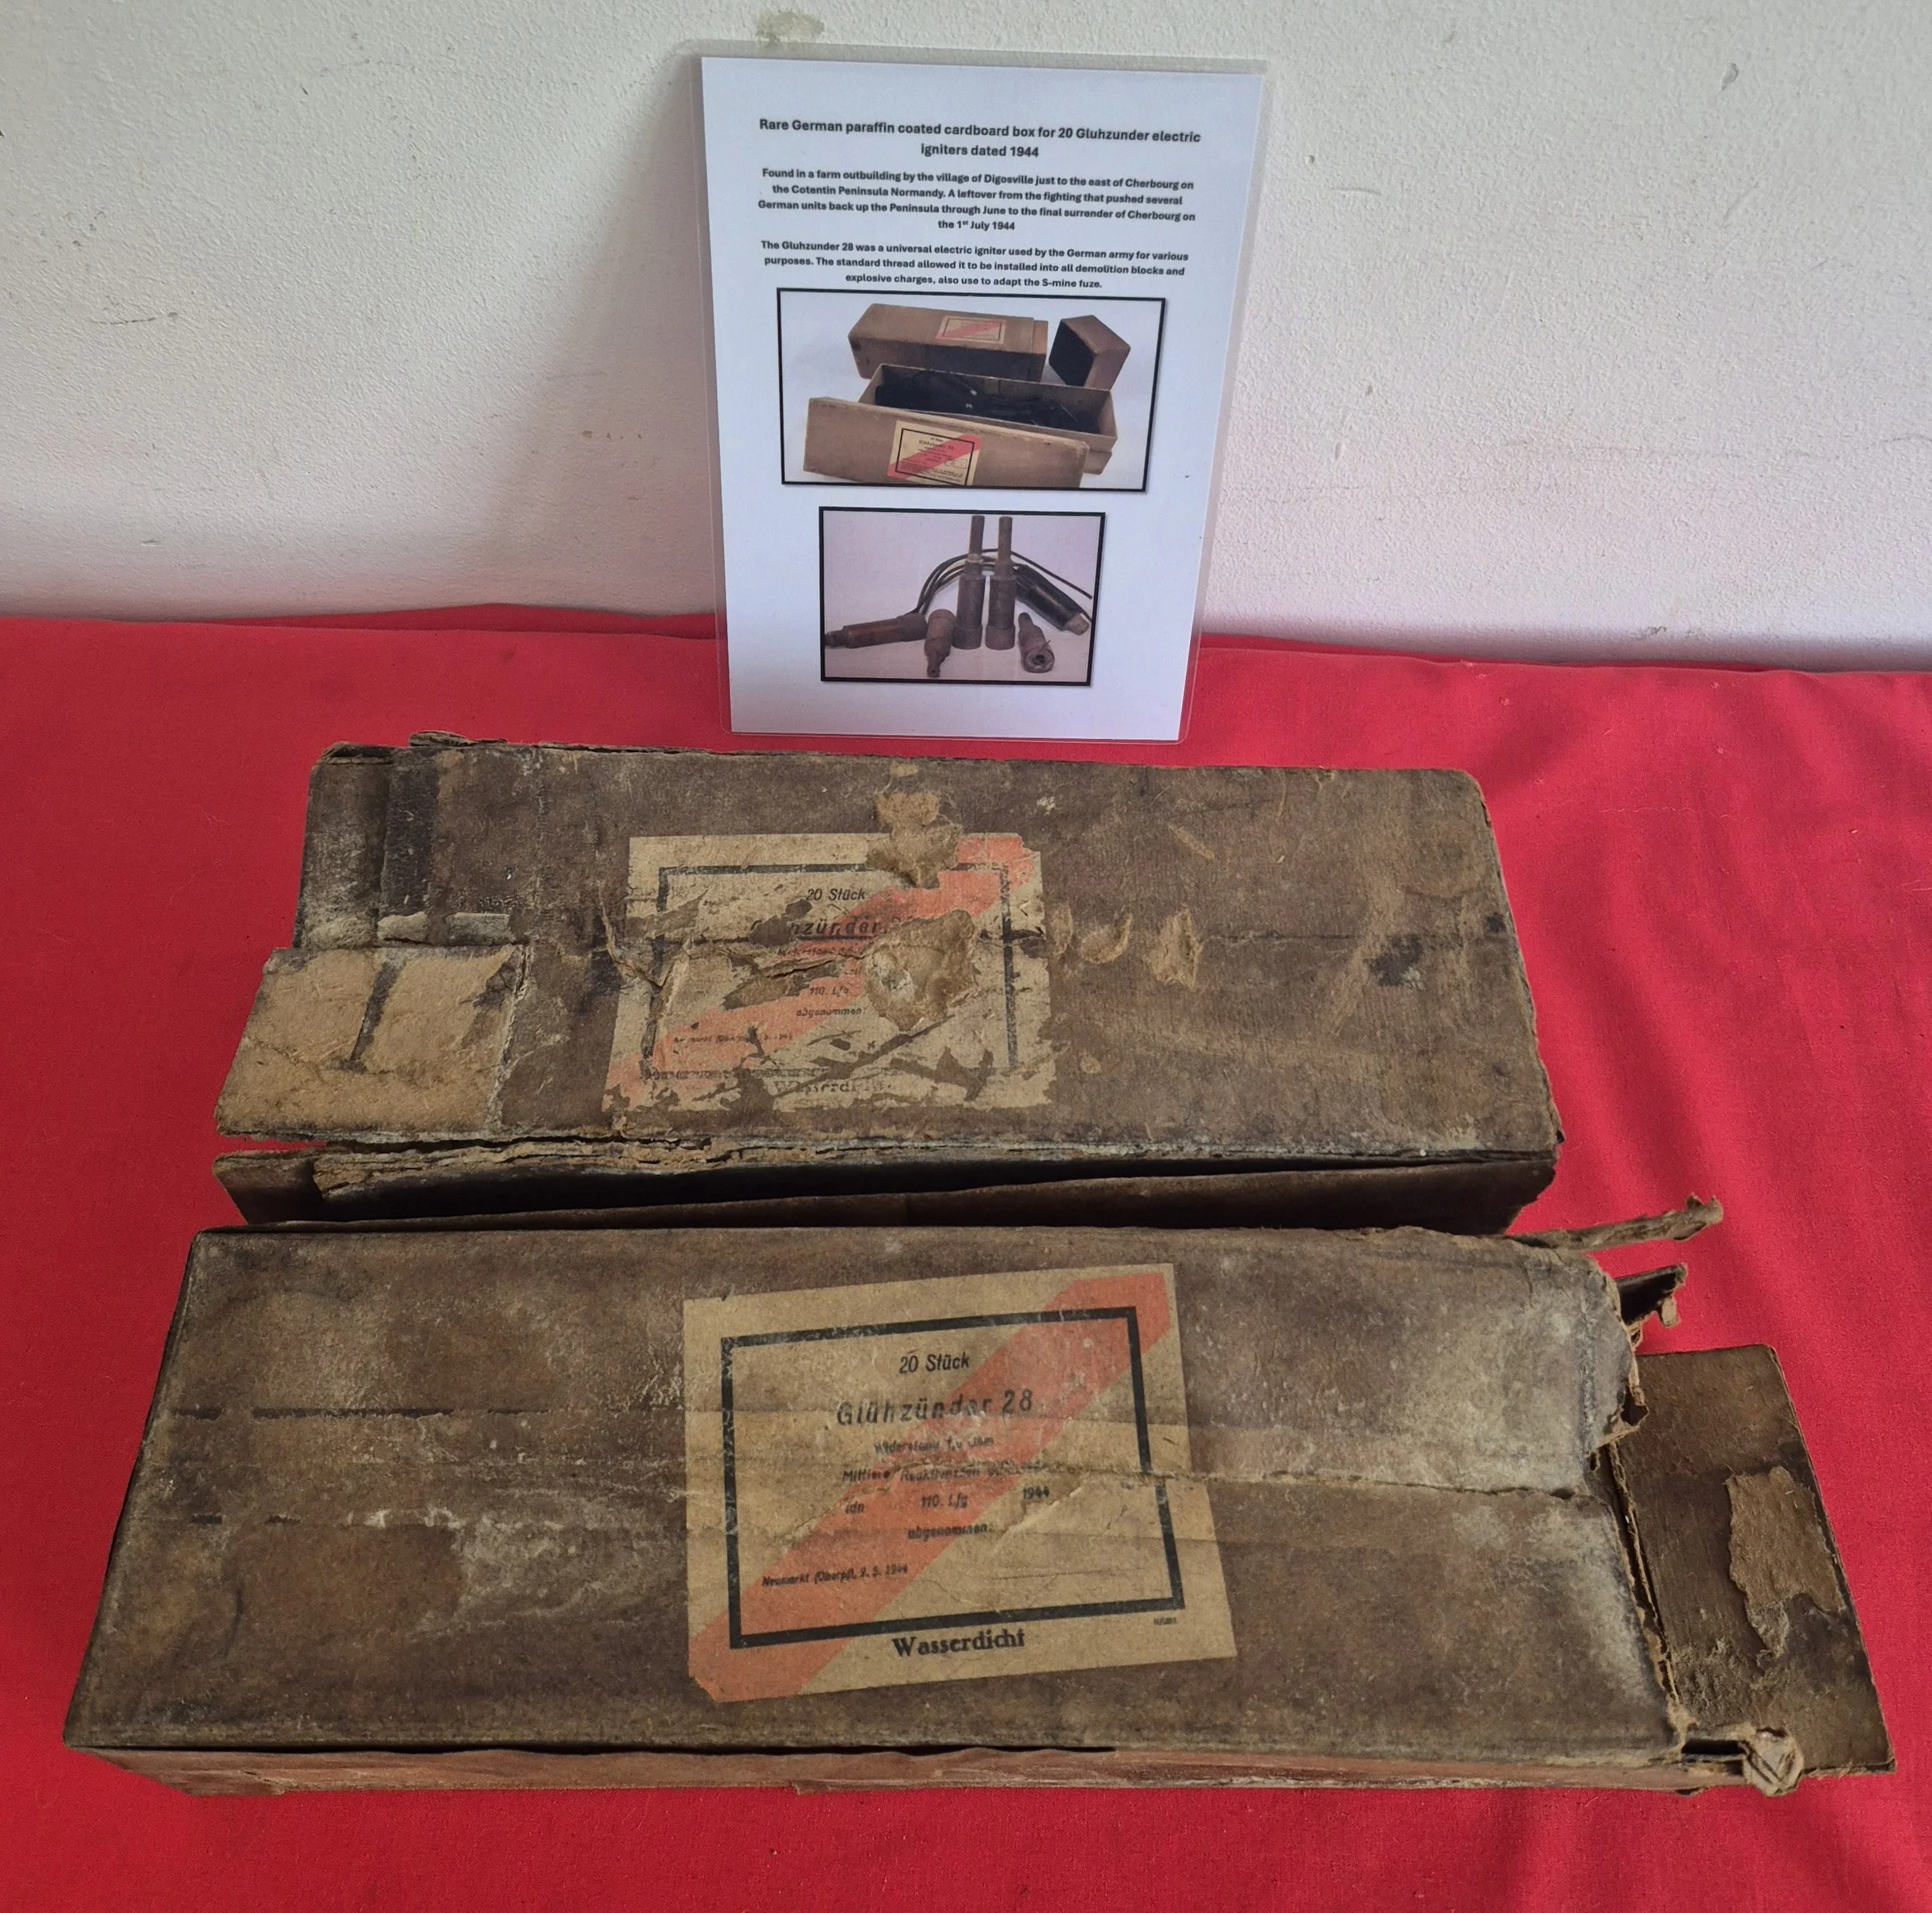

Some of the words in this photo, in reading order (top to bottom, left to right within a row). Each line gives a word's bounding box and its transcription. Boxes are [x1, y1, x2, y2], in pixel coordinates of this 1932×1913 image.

[759, 118, 789, 130] Rare
[791, 119, 843, 132] German
[845, 121, 895, 134] paraffin
[896, 124, 941, 134] coated
[944, 124, 1009, 137] cardboard
[1012, 126, 1036, 138] box
[1037, 127, 1056, 138] for
[1057, 127, 1073, 138] 20
[1076, 128, 1150, 141] Gluhzunder
[1151, 130, 1201, 142] electric
[921, 143, 968, 157] igniters
[971, 145, 1007, 157] dated
[1010, 146, 1039, 158] 1944
[762, 168, 794, 178] Found
[796, 168, 806, 179] in
[815, 169, 841, 179] farm
[843, 171, 902, 182] outbuilding
[903, 172, 916, 183] by
[916, 172, 934, 182] the
[936, 172, 969, 184] village
[971, 174, 982, 182] of
[984, 174, 1034, 186] Digosville
[1034, 175, 1056, 189] just
[1056, 177, 1068, 186] to
[1069, 176, 1087, 186] the
[1112, 178, 1124, 187] of
[1125, 178, 1180, 191] Cherbourg
[772, 184, 790, 194] the
[791, 185, 836, 195] Cotentin
[838, 186, 889, 196] Peninsula
[890, 187, 946, 199] Normandy.
[947, 189, 955, 198] A
[957, 189, 997, 199] leftover
[998, 190, 1023, 200] from
[1024, 191, 1042, 200] the
[1042, 191, 1082, 203] fighting
[1082, 192, 1105, 203] that
[1105, 194, 1145, 205] pushed
[1145, 196, 1182, 205] several
[758, 199, 800, 209] German
[801, 201, 827, 210] units
[828, 201, 854, 211] back
[855, 204, 869, 213] up
[870, 203, 887, 212] the
[889, 203, 940, 213] Peninsula
[940, 204, 981, 216] through
[982, 206, 1006, 215] June
[1020, 206, 1038, 216] the
[1039, 207, 1063, 216] final
[1064, 209, 1114, 218] surrender
[1115, 209, 1127, 219] of
[1128, 210, 1182, 223] Cherbourg
[937, 220, 954, 229] the
[970, 220, 990, 232] July
[992, 221, 1015, 230] 1944
[760, 240, 780, 250] The
[781, 241, 840, 250] Gluhzunder
[842, 242, 854, 251] 28
[886, 244, 932, 254] universal
[934, 245, 972, 254] electric
[975, 246, 1007, 257] igniter
[1009, 247, 1032, 256] used
[1035, 247, 1047, 258] by
[1048, 248, 1065, 257] the
[1066, 249, 1107, 258] German
[1108, 251, 1134, 261] army
[1136, 250, 1151, 260] for
[1152, 251, 1189, 261] various
[764, 257, 814, 267] purposes.
[815, 257, 834, 266] The
[836, 258, 880, 267] standard
[882, 259, 915, 267] thread
[917, 260, 956, 269] allowed
[958, 260, 965, 269] it
[980, 261, 992, 270] be
[994, 261, 1037, 271] installed
[1039, 263, 1059, 271] into
[1060, 264, 1073, 272] all
[1075, 264, 1129, 274] demolition
[1131, 266, 1165, 275] blocks
[1165, 267, 1185, 276] and
[845, 273, 892, 284] explosive
[893, 274, 936, 285] charges,
[938, 276, 959, 284] also
[993, 277, 1022, 288] adapt
[1024, 278, 1040, 287] the
[1042, 278, 1077, 288] S-mine
[1079, 279, 1102, 288] fuze.
[806, 889, 822, 901] 20
[828, 888, 866, 901] Stück
[899, 1355, 919, 1373] 20
[926, 1351, 970, 1372] Stück
[836, 1393, 992, 1426] Glühzünder
[1002, 1388, 1033, 1415] 28
[892, 1627, 1025, 1658] Wasserdicht
